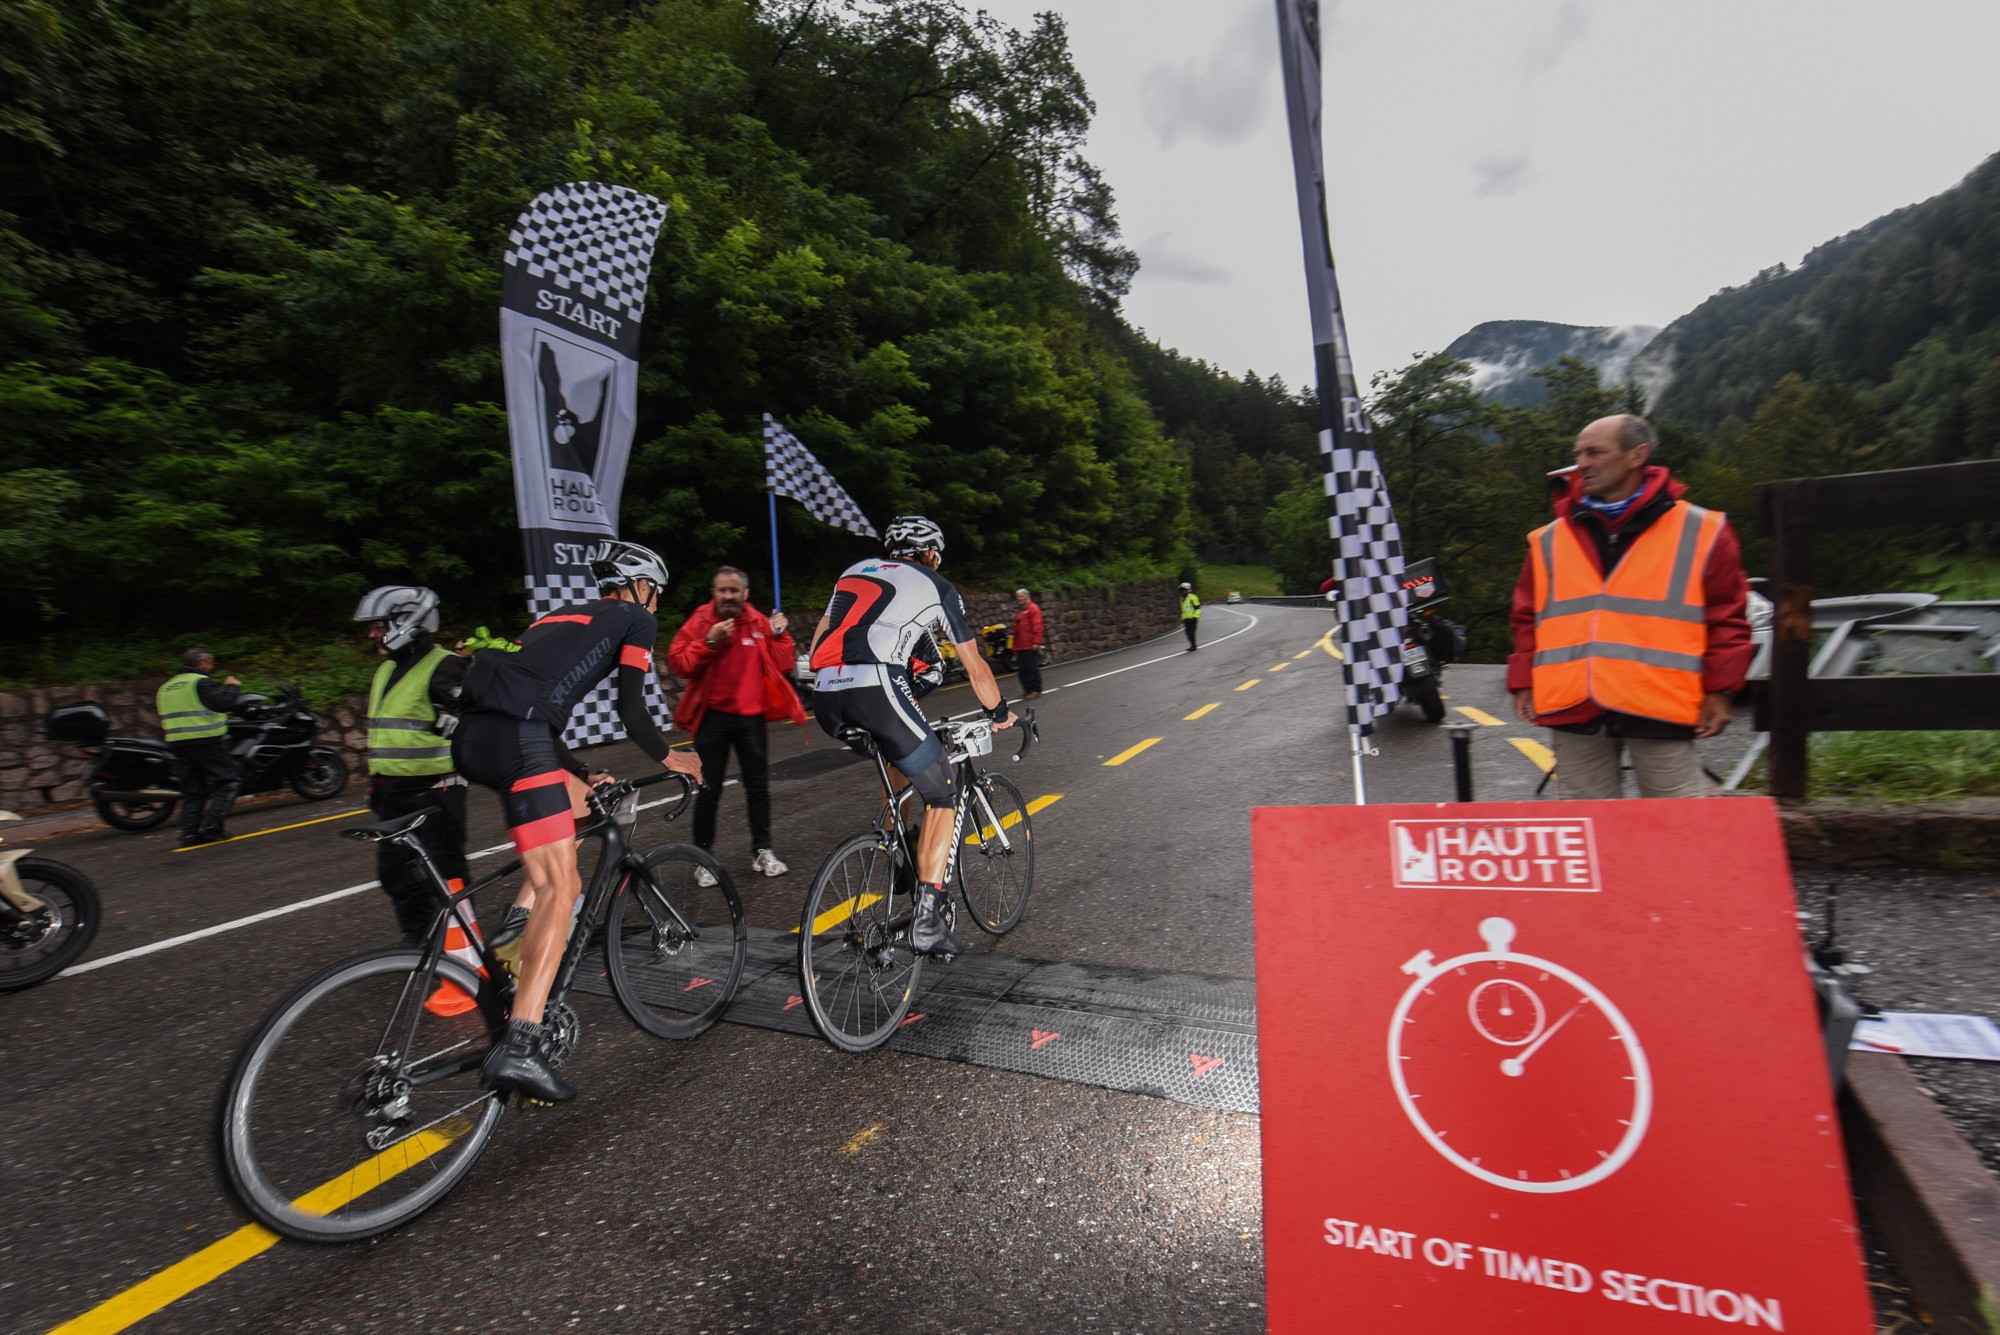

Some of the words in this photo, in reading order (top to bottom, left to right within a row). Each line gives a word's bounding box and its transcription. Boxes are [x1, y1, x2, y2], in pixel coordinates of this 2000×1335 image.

[535, 289, 622, 340] START
[550, 477, 596, 499] HAU
[1436, 826, 1586, 857] HAUTE
[1440, 858, 1590, 883] ROUTE
[1324, 1217, 1416, 1261] START
[1423, 1237, 1473, 1271] OF
[1479, 1245, 1592, 1293] TIMED
[1602, 1268, 1784, 1332] SECTION
